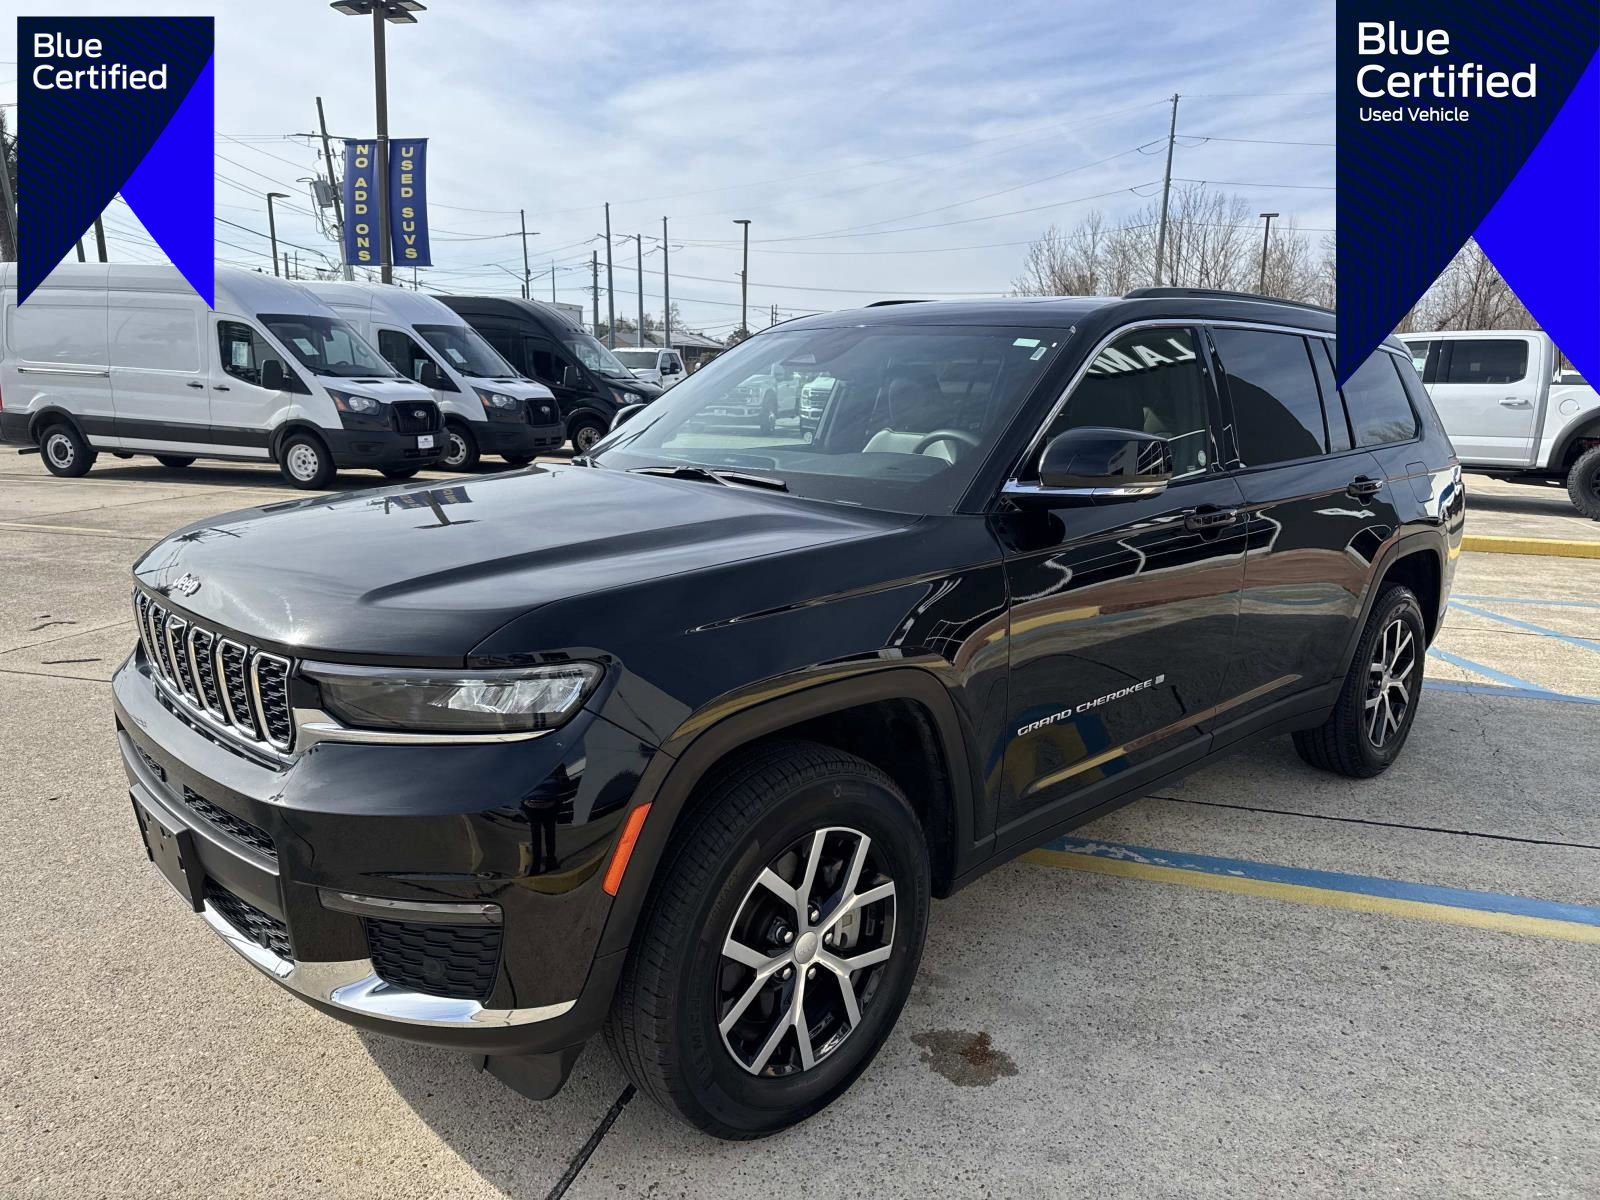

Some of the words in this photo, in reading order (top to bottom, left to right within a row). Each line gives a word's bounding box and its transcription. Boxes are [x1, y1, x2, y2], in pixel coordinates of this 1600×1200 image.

[355, 144, 369, 168] NO
[400, 147, 414, 198] USED
[355, 177, 368, 214] ADD
[355, 224, 371, 261] ONS
[402, 207, 418, 259] SUVS
[173, 572, 200, 596] Jeep
[1017, 708, 1072, 737] GRAND
[1075, 678, 1153, 714] CHEROKEE
